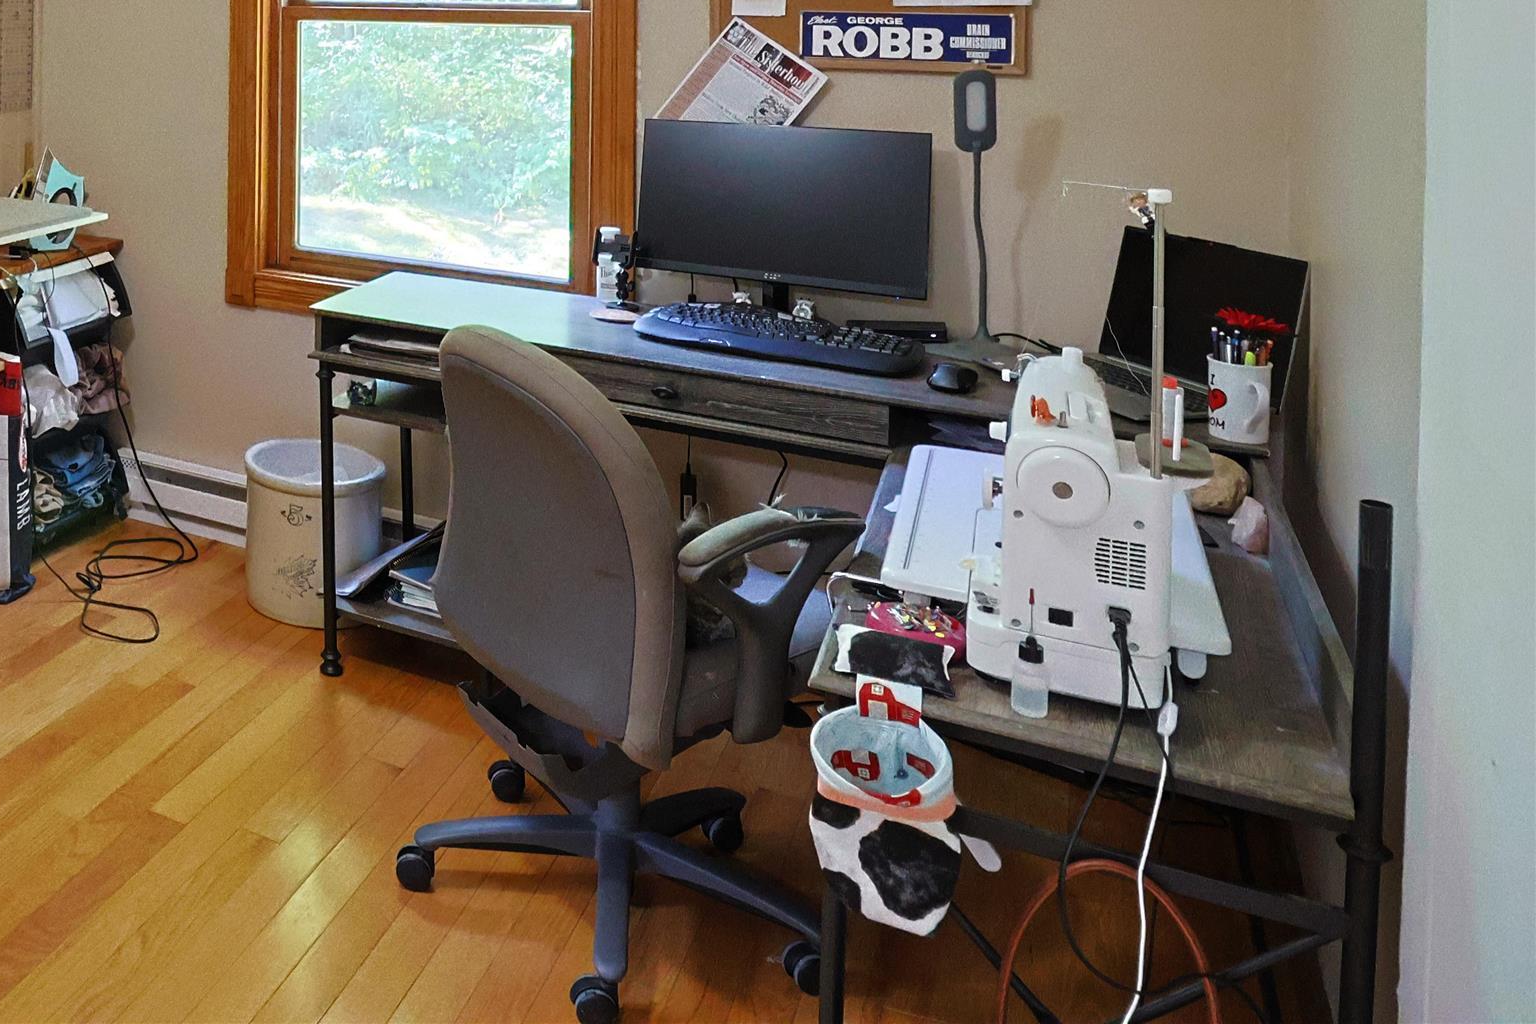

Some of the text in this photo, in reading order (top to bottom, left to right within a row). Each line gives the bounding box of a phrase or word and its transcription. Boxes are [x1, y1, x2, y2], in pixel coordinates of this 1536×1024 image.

[846, 16, 904, 25] GEORGE
[966, 23, 990, 36] DRAIN
[811, 25, 944, 60] ROBB
[949, 36, 1006, 50] COMMISSIONER
[1210, 373, 1216, 385] I
[16, 478, 30, 531] LAMB
[287, 503, 304, 527] 5
